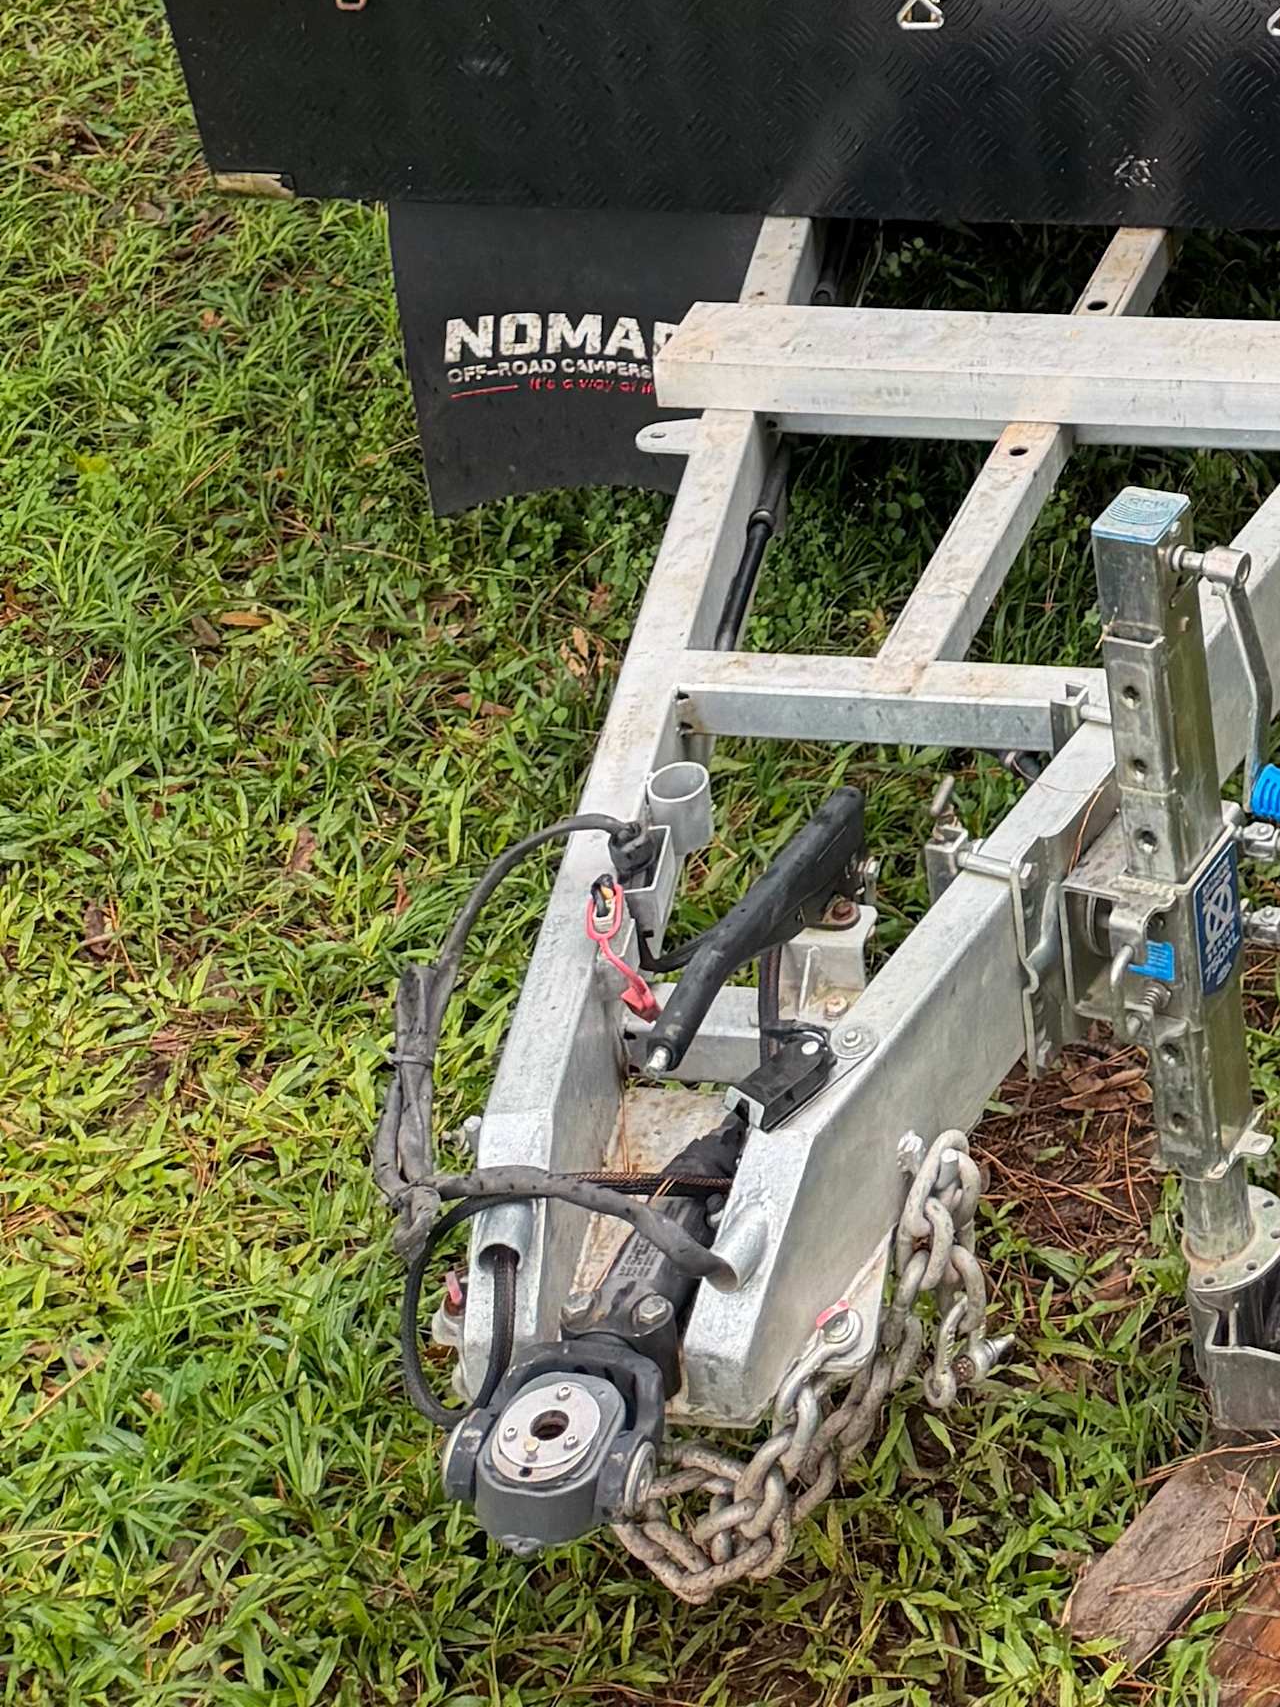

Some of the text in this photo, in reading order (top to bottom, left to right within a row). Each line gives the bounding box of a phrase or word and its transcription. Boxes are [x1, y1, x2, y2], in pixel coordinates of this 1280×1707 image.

[444, 312, 680, 363] NOMA
[447, 358, 653, 384] OFF-ROAD CAMPERS
